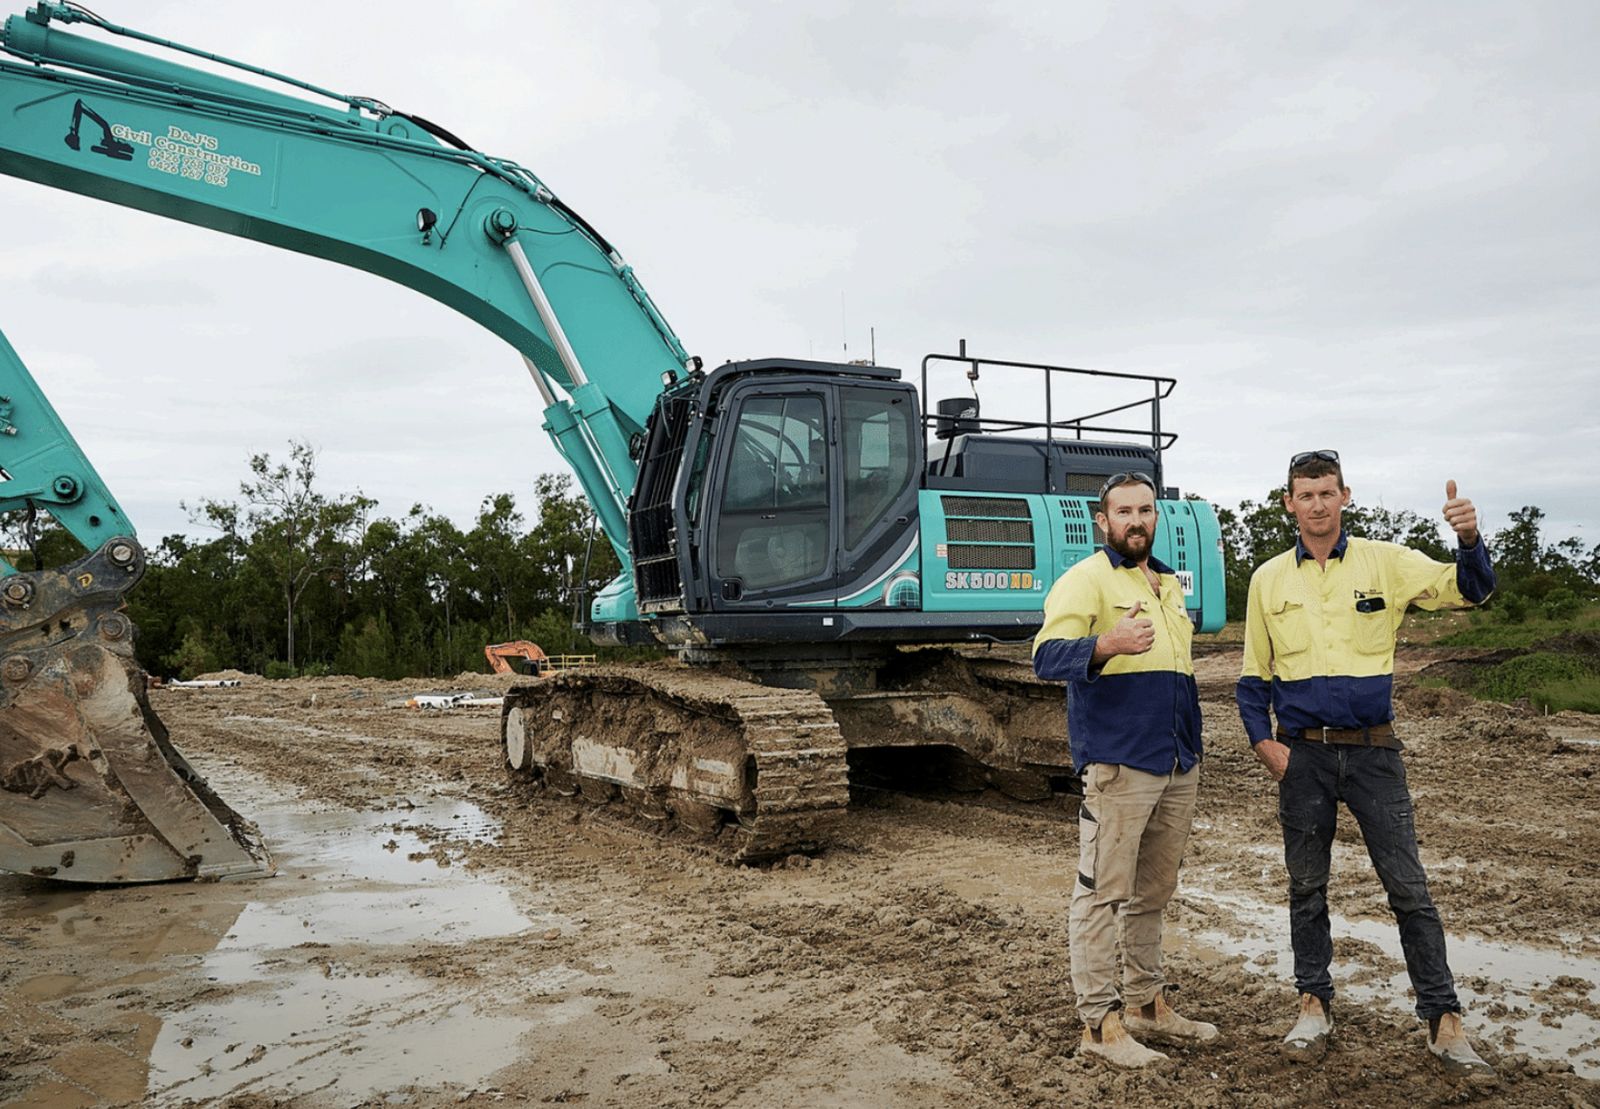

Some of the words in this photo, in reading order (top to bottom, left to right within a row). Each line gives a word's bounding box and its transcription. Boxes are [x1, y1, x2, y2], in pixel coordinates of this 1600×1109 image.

[111, 124, 152, 146] Civil
[154, 137, 261, 176] Construction
[169, 125, 218, 150] D&J'S
[150, 148, 180, 164] 0426
[148, 158, 179, 174] 0426
[204, 173, 229, 187] 095
